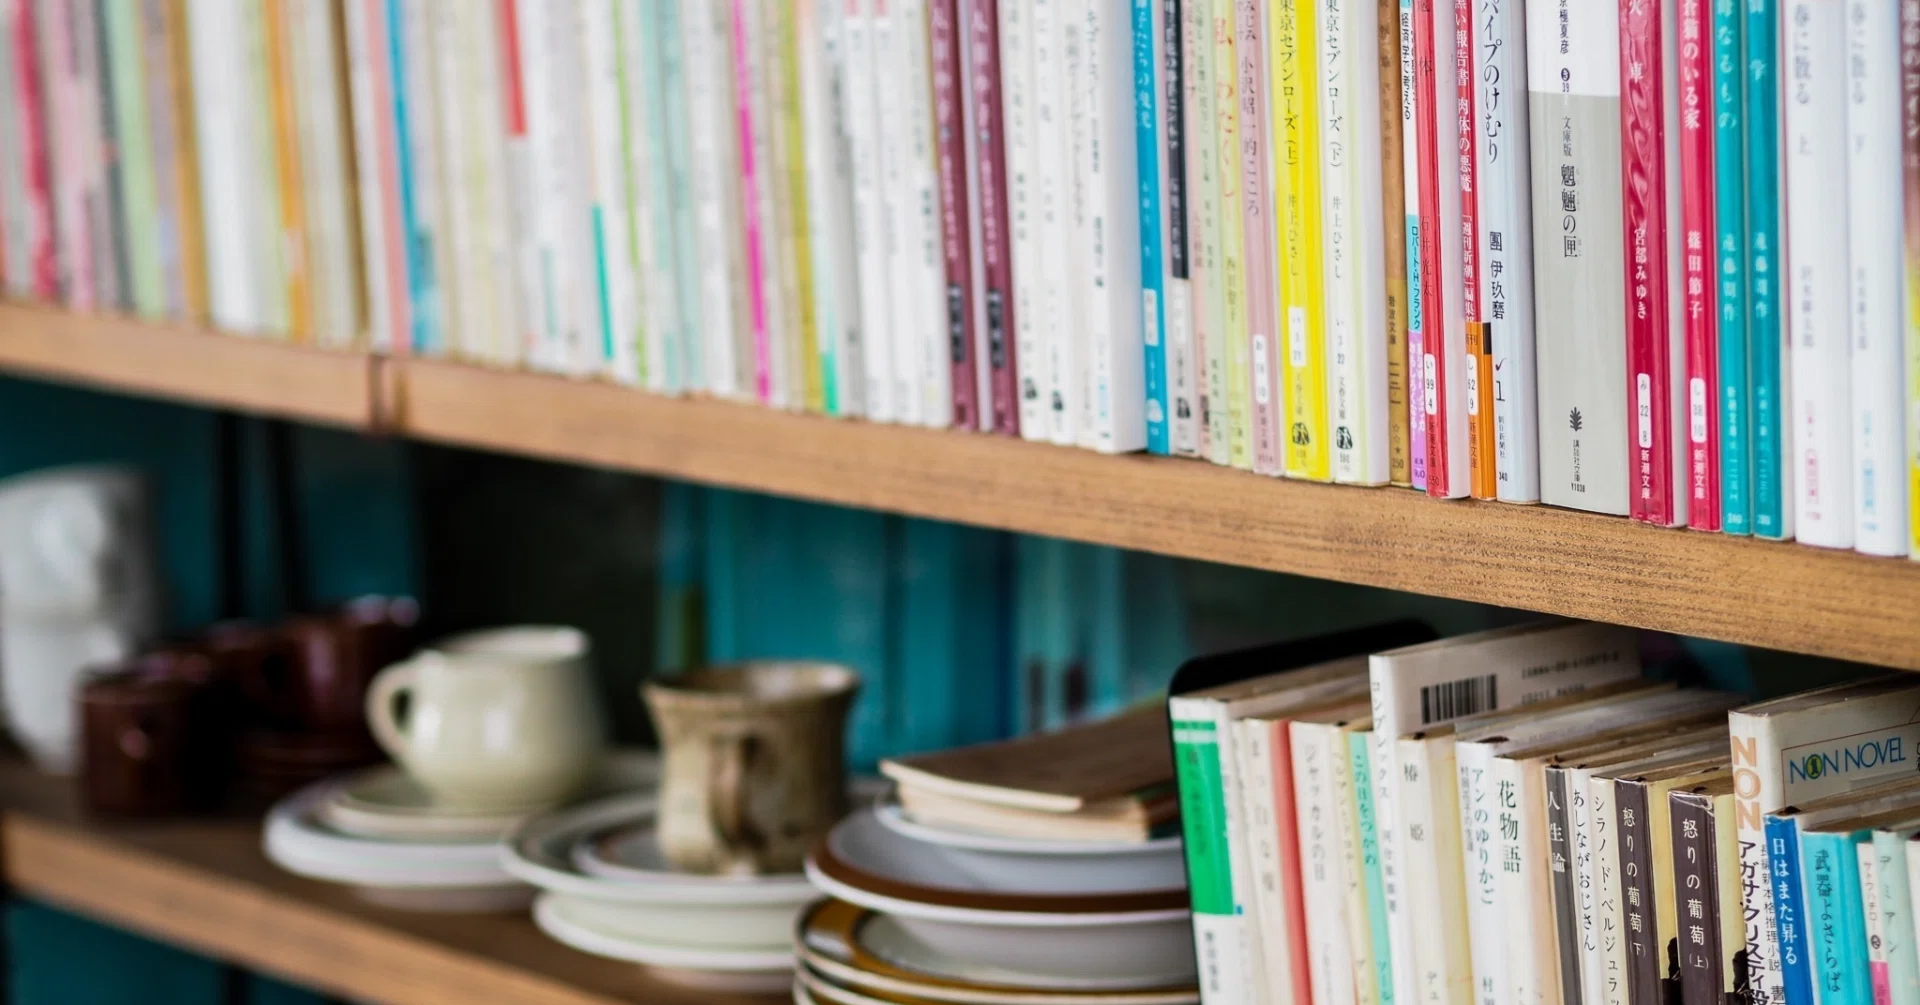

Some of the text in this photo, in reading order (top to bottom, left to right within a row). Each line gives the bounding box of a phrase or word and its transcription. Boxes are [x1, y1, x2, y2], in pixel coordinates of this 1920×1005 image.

[1562, 116, 1572, 157] 文庫版
[1634, 228, 1647, 319] 宮部みゆき
[1687, 230, 1703, 319] 篠田節子
[1425, 379, 1434, 390] 99
[1640, 405, 1649, 417] 22
[1641, 449, 1650, 499] 新潮文庫
[1693, 448, 1705, 499] 新潮文庫
[1731, 736, 1762, 831] NON
[1844, 736, 1907, 773] NOVEL
[1472, 768, 1495, 905] アンのゆりかご
[1497, 780, 1522, 873] 花物語
[1548, 791, 1566, 873] 人生論
[1573, 790, 1596, 952] あしながおじさん
[1773, 838, 1798, 965] 日はまた昇る
[1814, 849, 1842, 993] 武器よさらば
